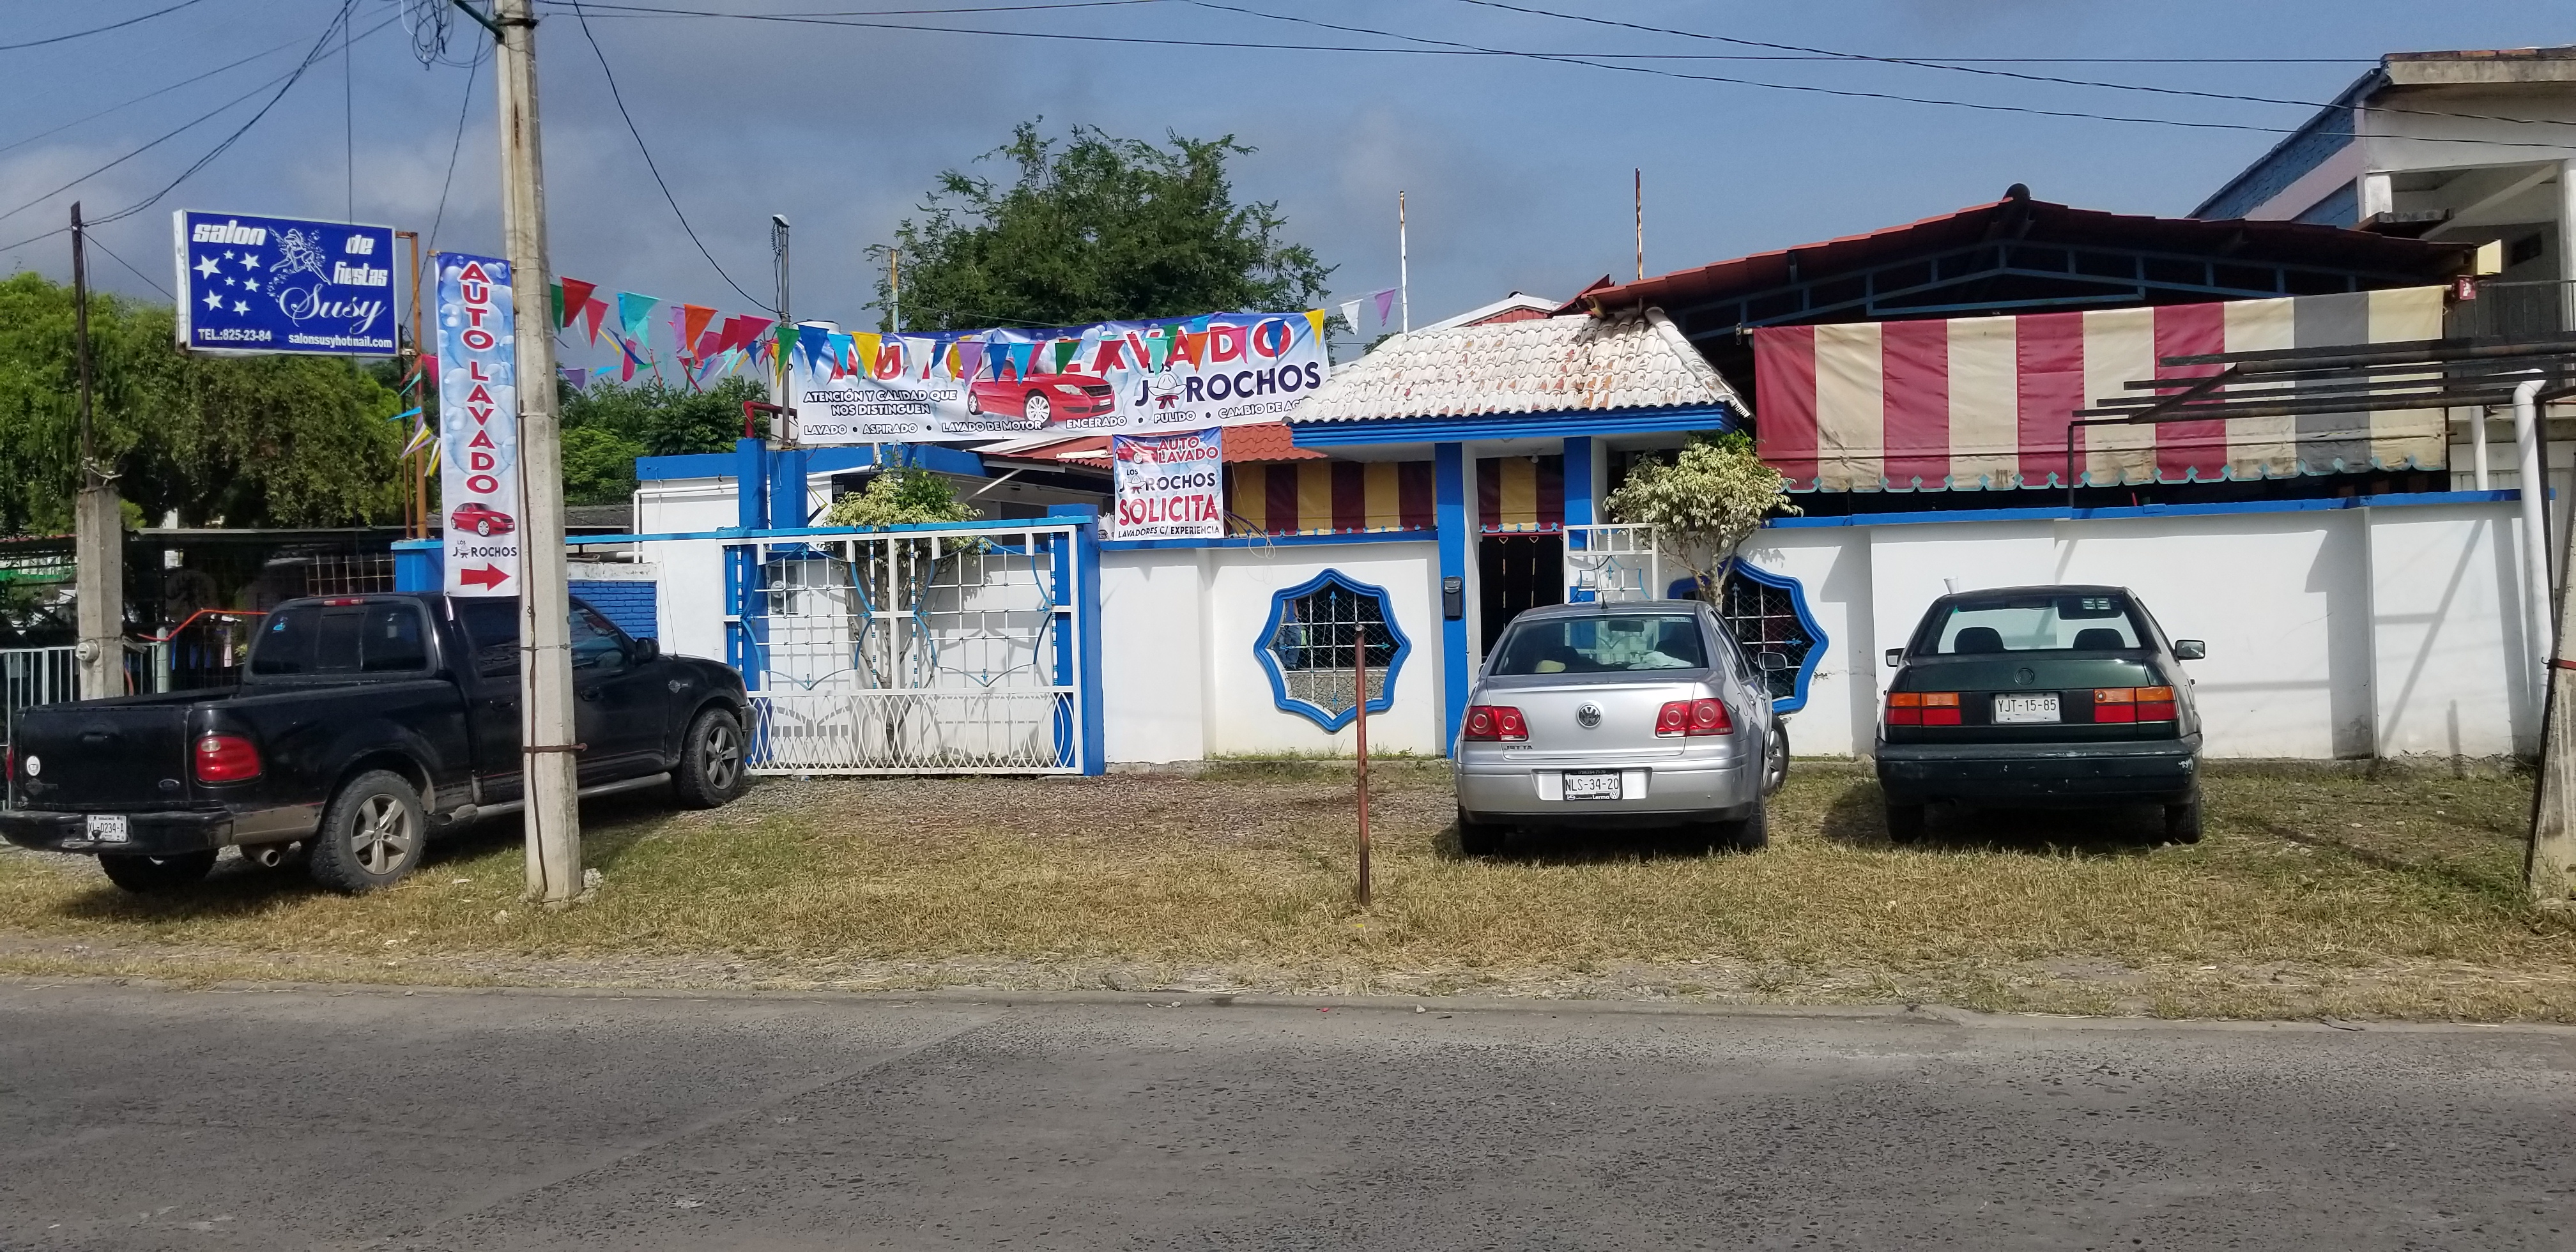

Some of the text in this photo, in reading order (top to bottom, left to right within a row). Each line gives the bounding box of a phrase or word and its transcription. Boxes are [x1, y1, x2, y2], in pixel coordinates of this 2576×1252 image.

[192, 220, 375, 255] salon de
[333, 261, 388, 287] fiestas
[279, 283, 387, 335] Susy
[458, 262, 494, 350] AUTO
[803, 388, 958, 403] ATENCIÓN Y CALIDAD QUE
[804, 424, 848, 435] LAVADO
[862, 423, 918, 434] ASPIRADO
[942, 421, 985, 433] LAVADO
[986, 422, 1001, 432] DE
[1002, 420, 1043, 432] MOTOR
[1066, 416, 1127, 429] ENCERADO
[1154, 410, 1197, 424] PULIDO
[1218, 403, 1265, 419] CAMBIO
[1266, 402, 1282, 414] DE
[831, 403, 930, 416] NOS DISTINGUEN
[466, 360, 499, 494] LAVADO
[1158, 436, 1199, 451] AUTO
[1158, 447, 1219, 464] LAVADO
[1119, 493, 1220, 526] SOLICITA
[1118, 525, 1220, 538] LAVADORES C/ EXPERIENCIA
[1998, 699, 2057, 713] YJT-15-85
[1565, 777, 1620, 791] NLS-34-20
